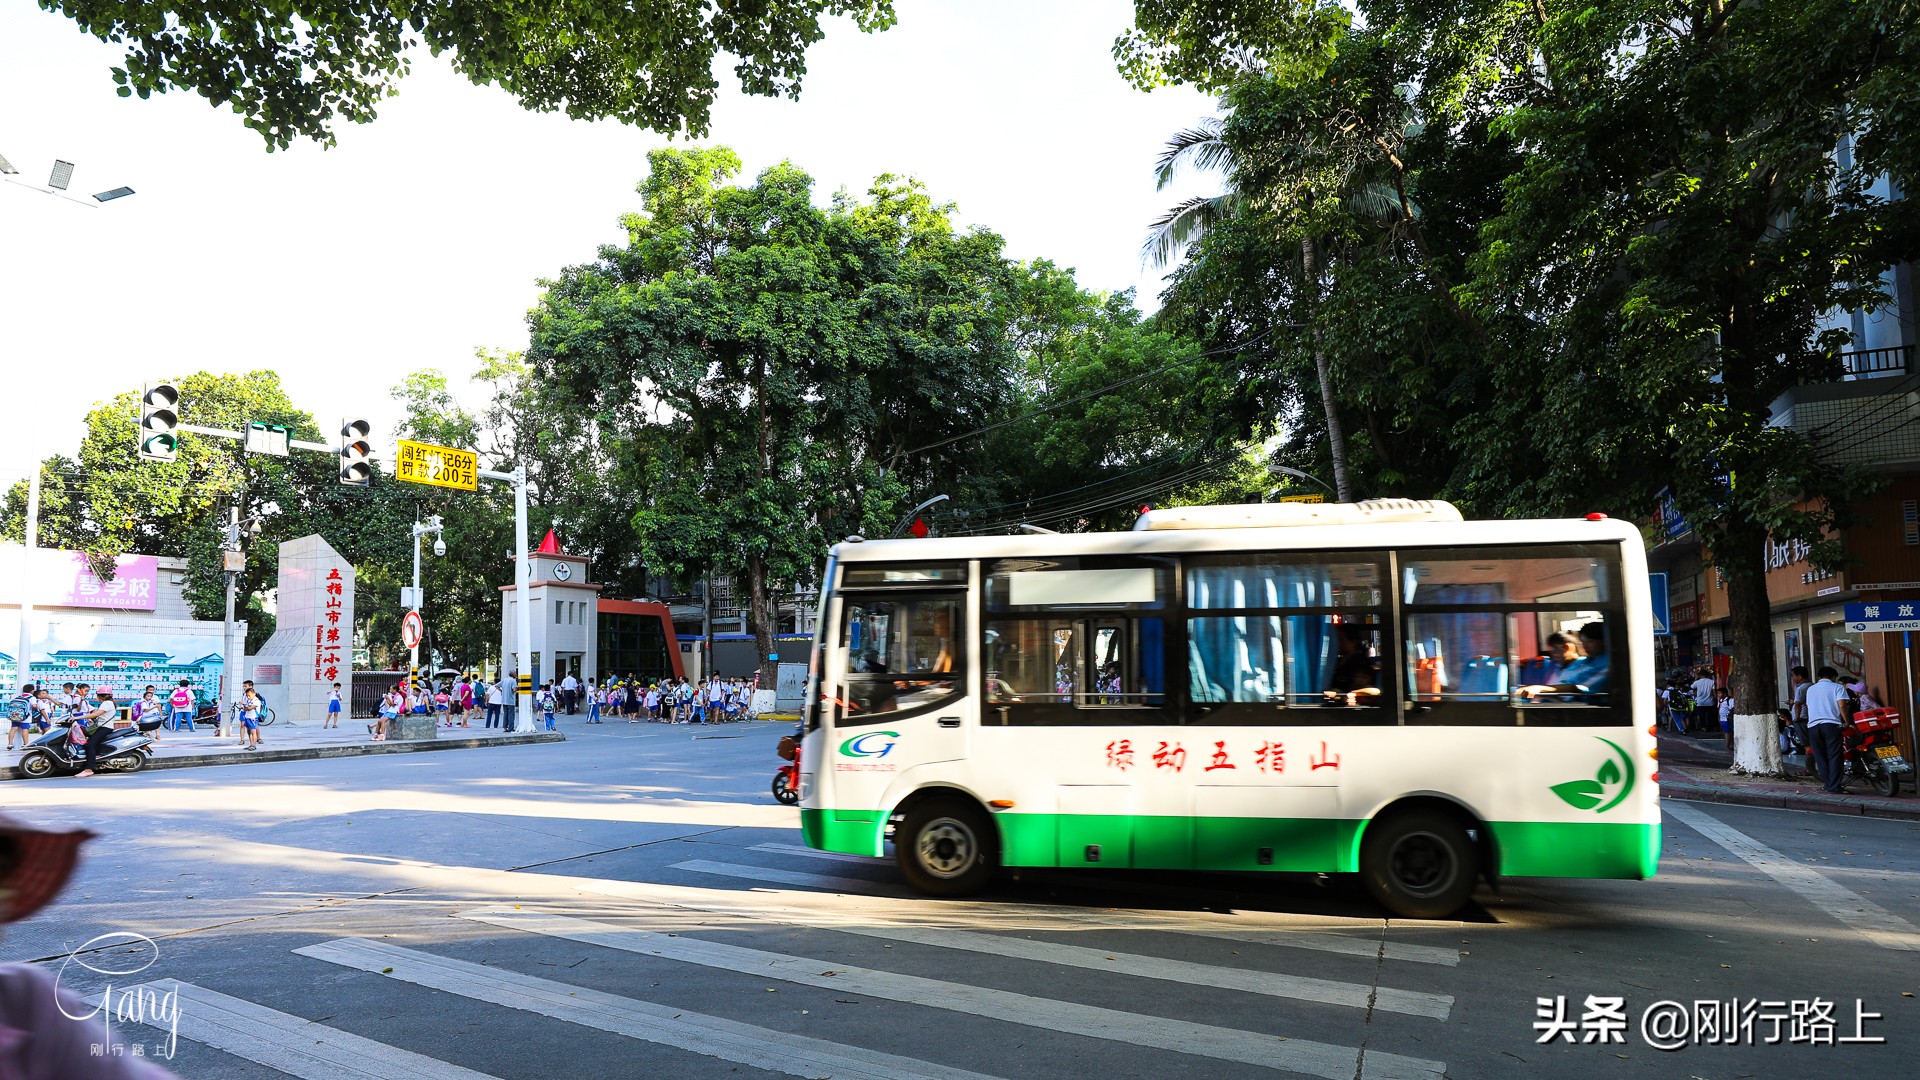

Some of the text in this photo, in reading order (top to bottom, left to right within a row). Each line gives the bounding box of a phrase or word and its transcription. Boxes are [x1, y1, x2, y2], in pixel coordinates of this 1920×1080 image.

[402, 445, 472, 470] 闯红灯记6分
[402, 461, 472, 485] 罚款200元
[84, 597, 147, 606] 13687506912
[1864, 604, 1914, 618] 解放
[323, 568, 343, 682] 五指山市第一小学
[67, 658, 153, 669] 教育方针
[1105, 738, 1341, 775] 绿动五指山
